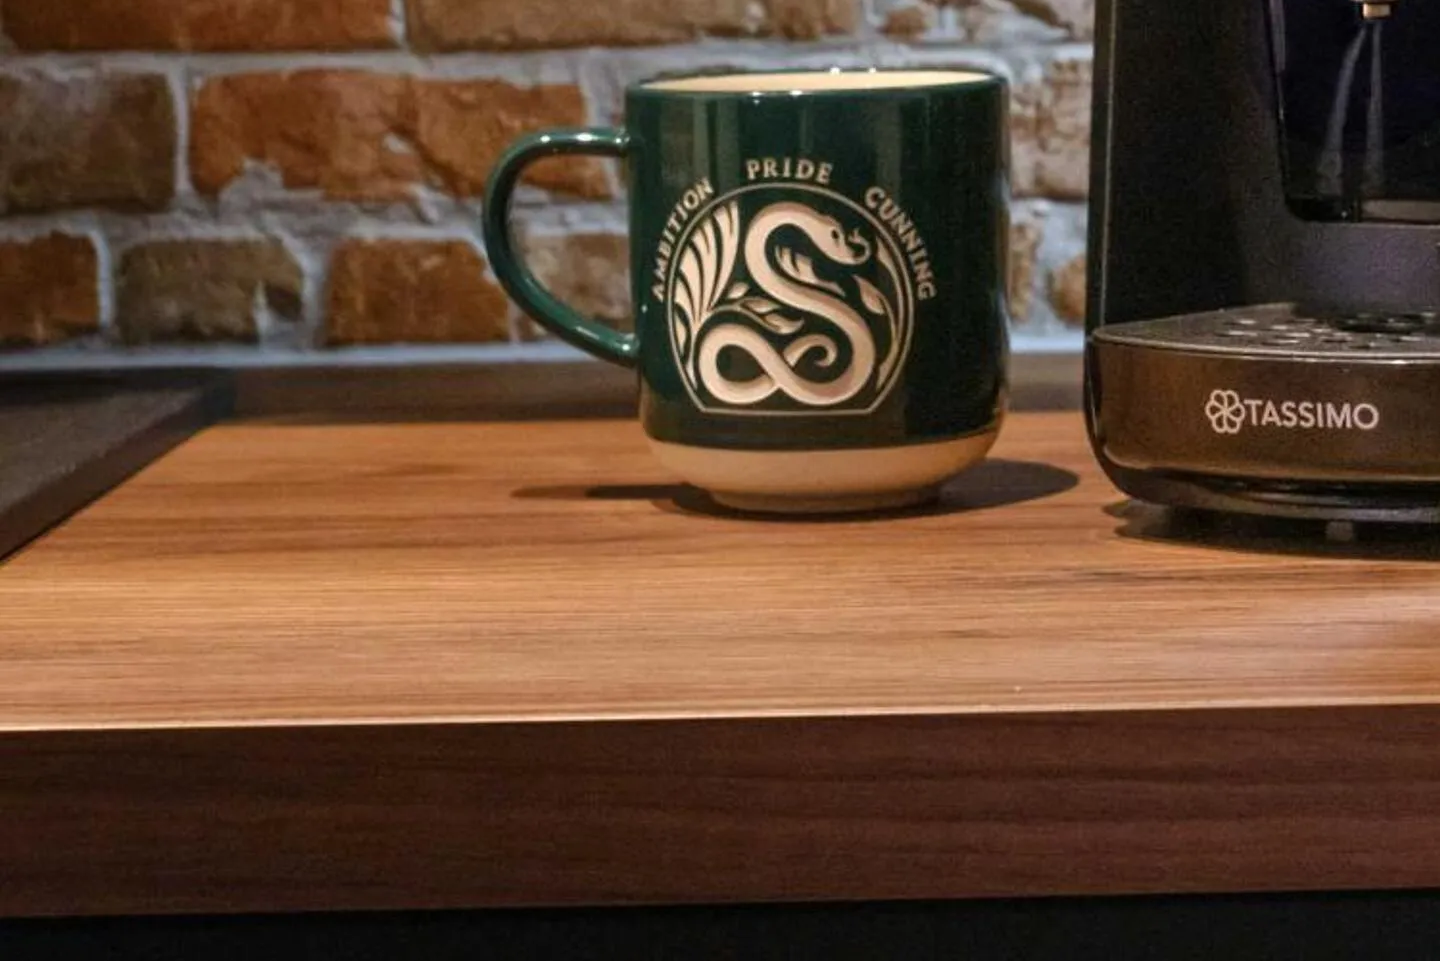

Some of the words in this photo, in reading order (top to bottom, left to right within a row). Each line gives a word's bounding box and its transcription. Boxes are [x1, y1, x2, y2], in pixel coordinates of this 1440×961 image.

[652, 178, 714, 302] AMBITION
[746, 158, 833, 184] PRIDE
[864, 186, 937, 300] CUNNING
[1244, 399, 1379, 430] TASSIMO
